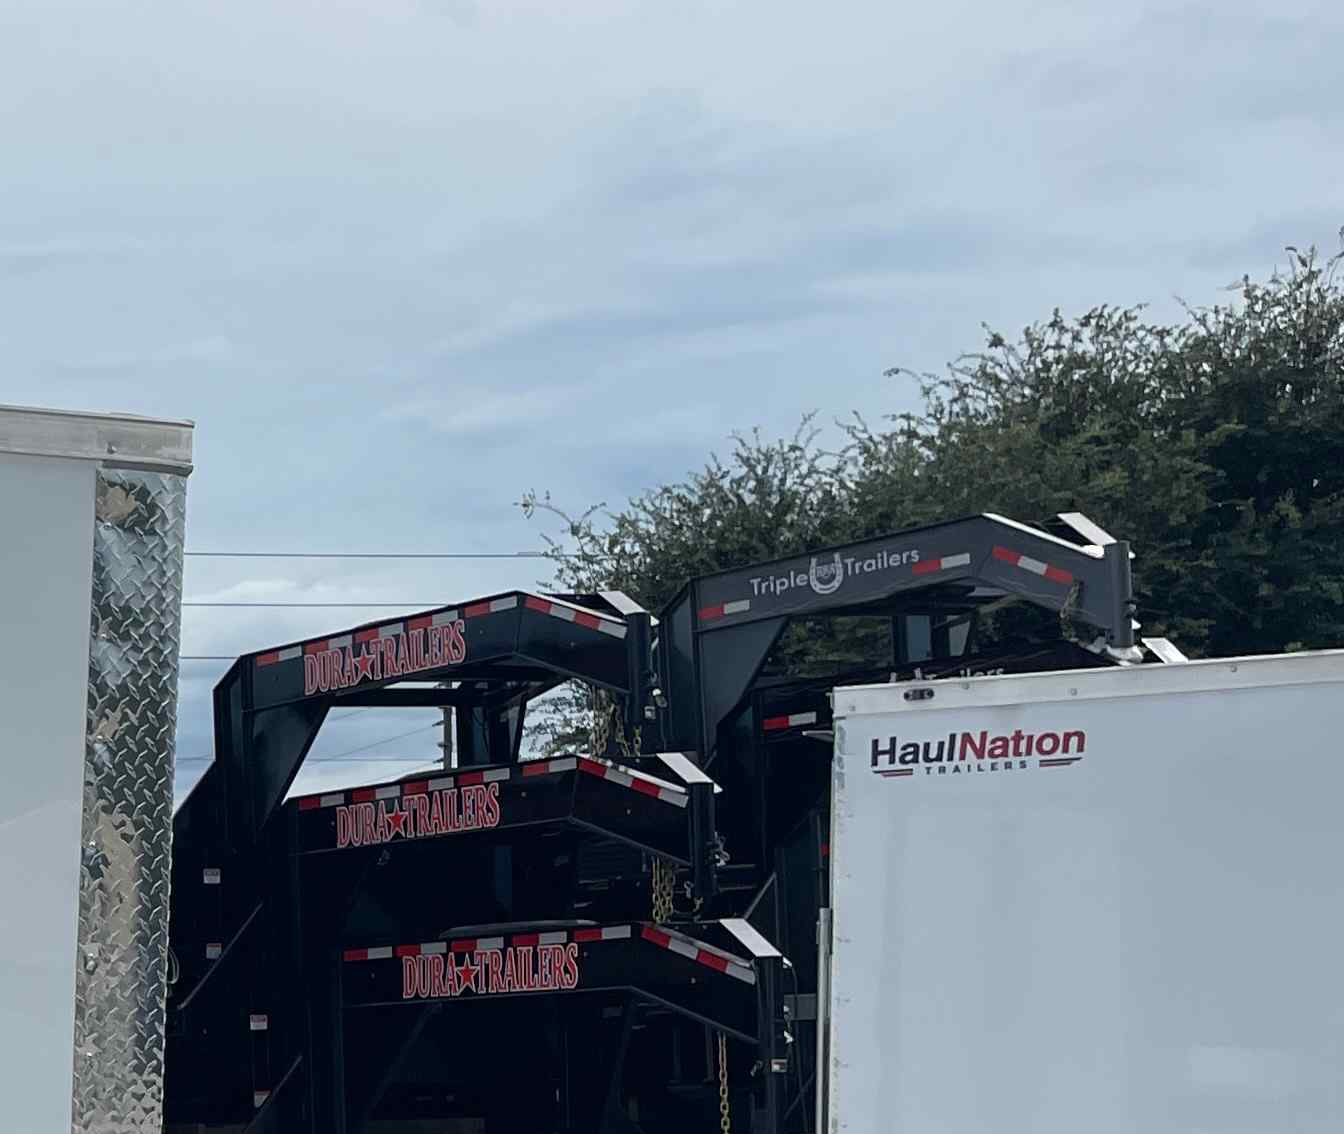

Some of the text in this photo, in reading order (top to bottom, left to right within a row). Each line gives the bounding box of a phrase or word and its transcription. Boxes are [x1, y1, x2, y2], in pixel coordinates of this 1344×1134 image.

[750, 570, 809, 596] Triple
[845, 549, 920, 576] Trailers
[304, 619, 466, 696] DURA TRAILERS
[871, 729, 1085, 768] HaulNation
[924, 759, 1028, 775] TRAILERS
[336, 782, 501, 848] DURA TRAILERS
[403, 943, 579, 999] DURA TRAILERS
